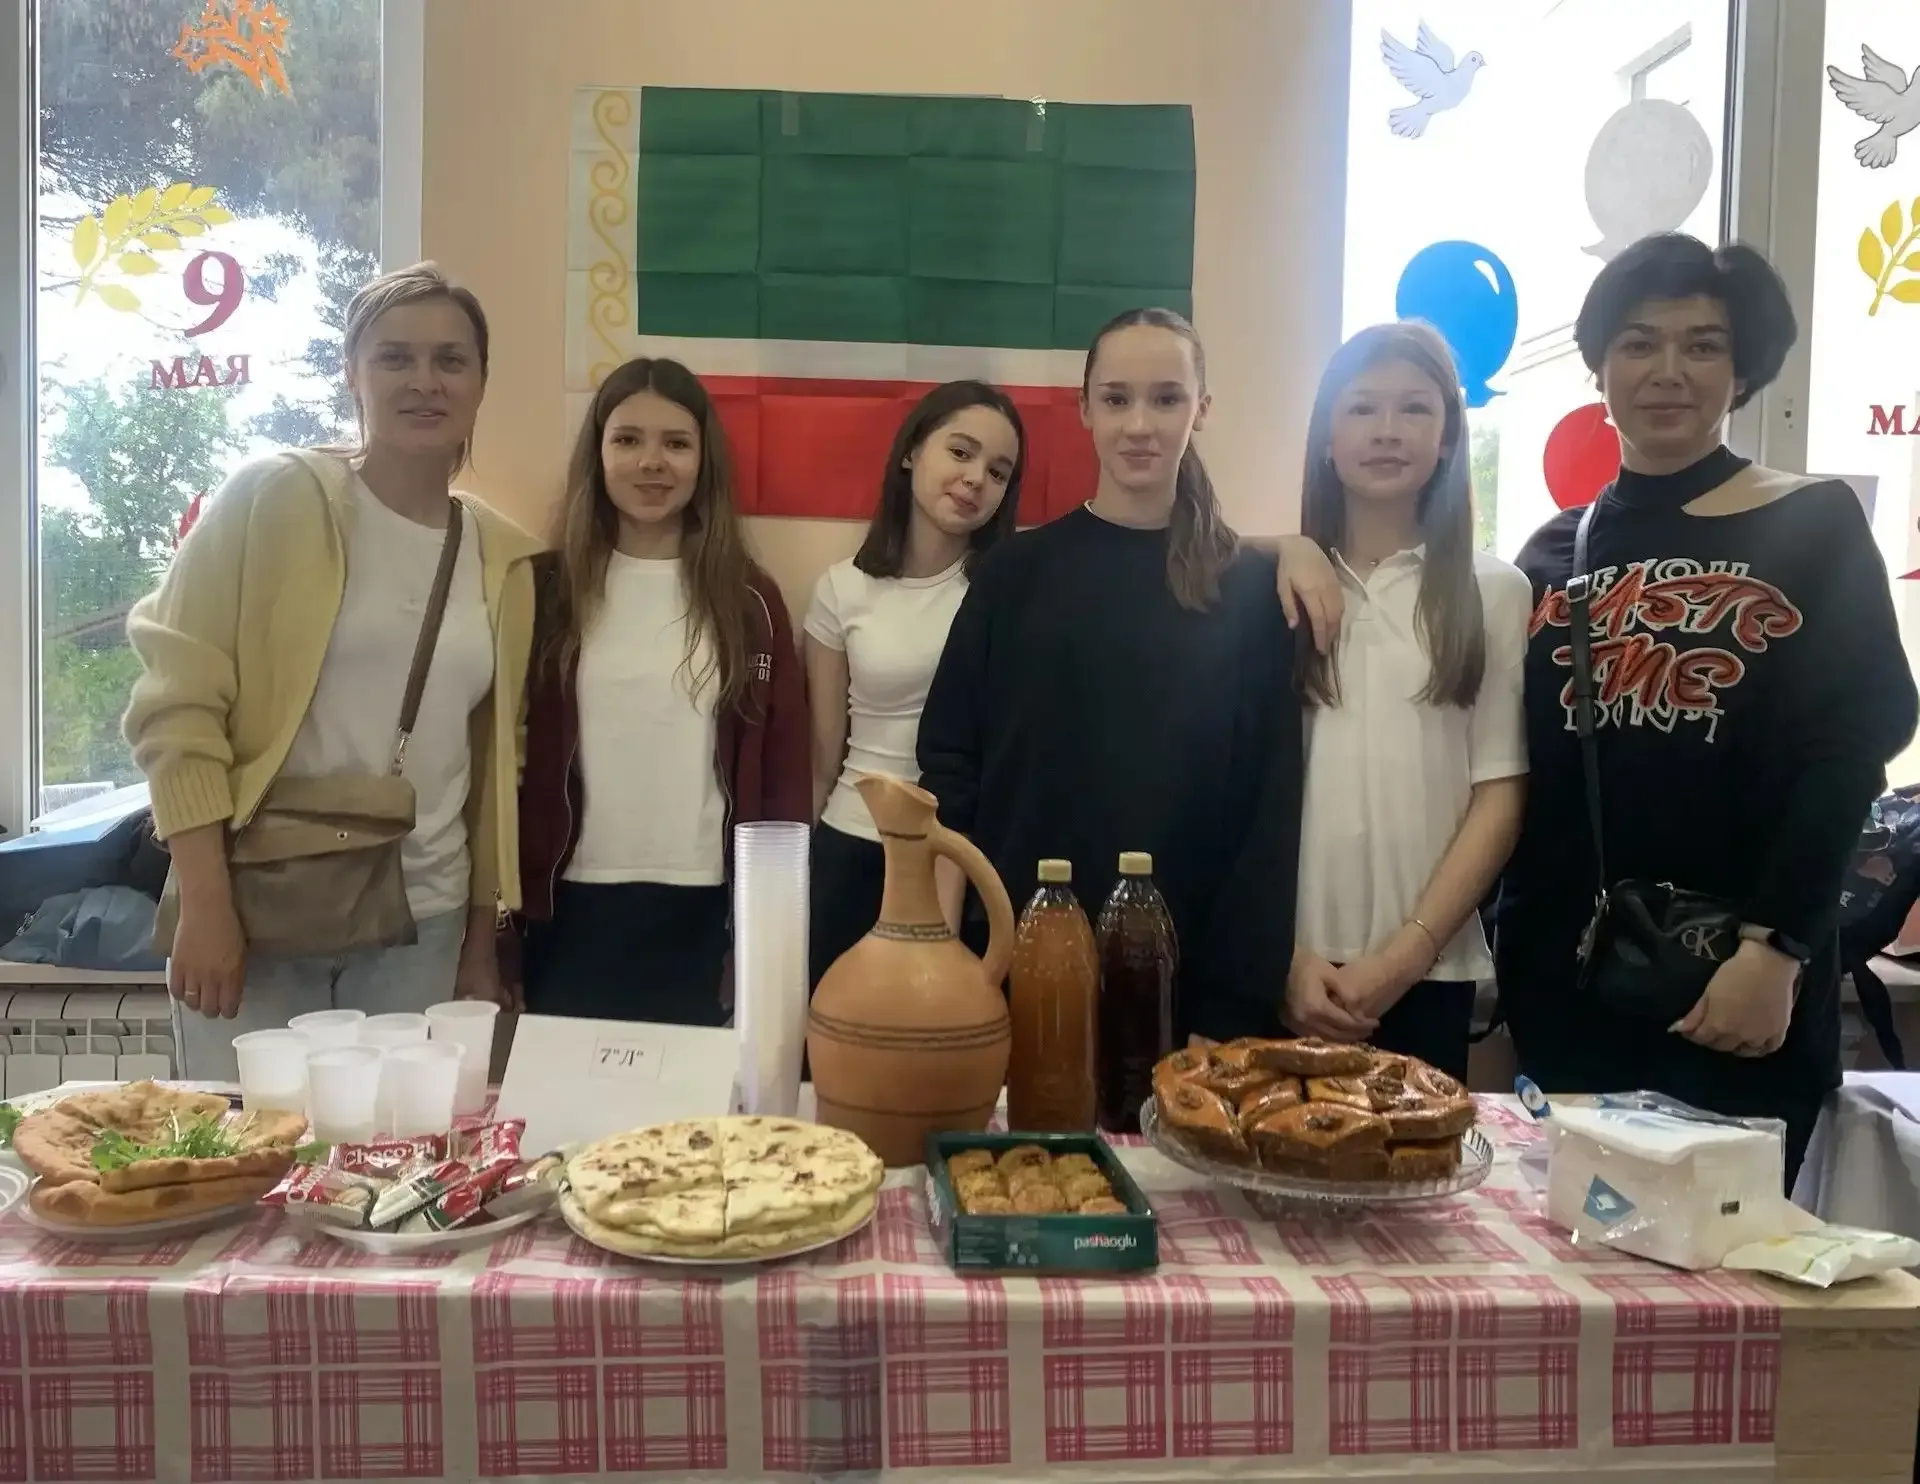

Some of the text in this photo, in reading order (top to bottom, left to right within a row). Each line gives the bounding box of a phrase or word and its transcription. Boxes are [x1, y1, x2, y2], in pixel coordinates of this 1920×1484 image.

[183, 251, 244, 338] 9
[148, 354, 253, 390] МАЯ
[1074, 1232, 1137, 1251] pashaoglu
